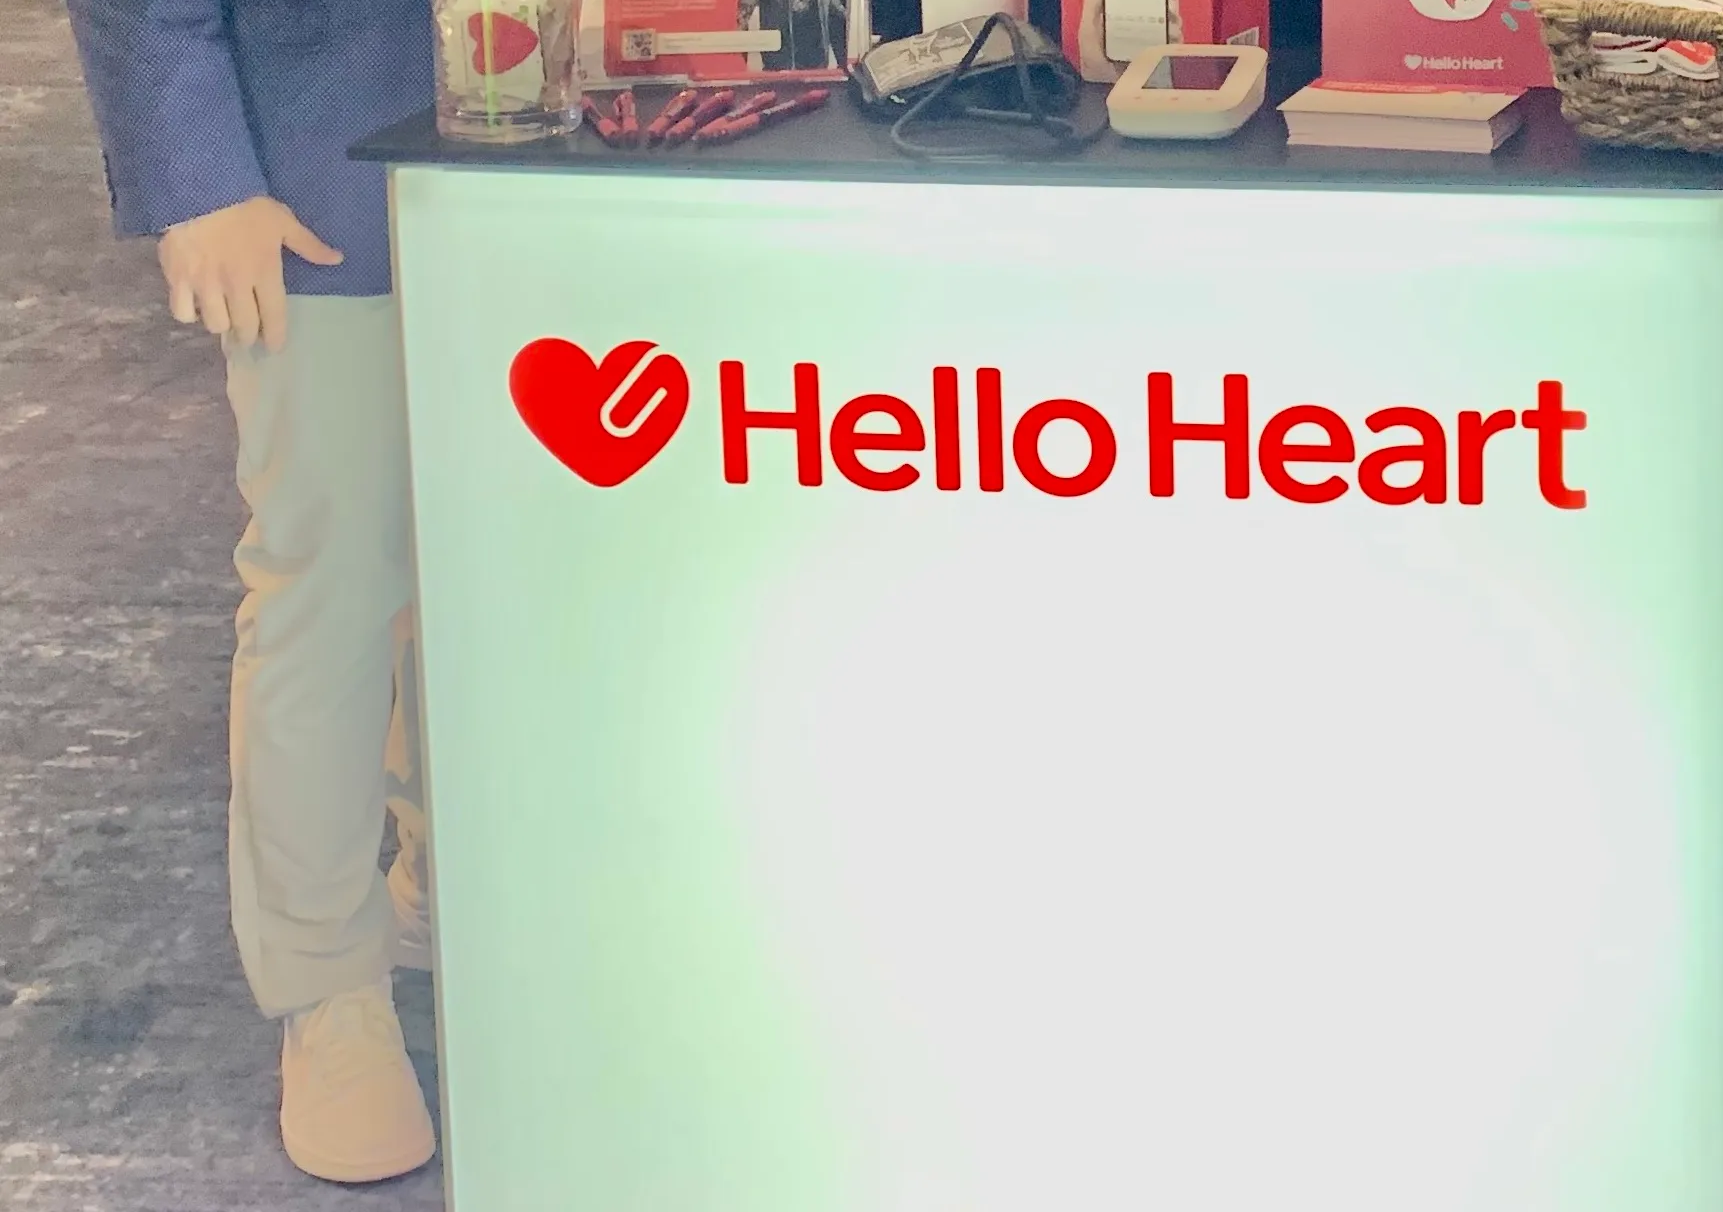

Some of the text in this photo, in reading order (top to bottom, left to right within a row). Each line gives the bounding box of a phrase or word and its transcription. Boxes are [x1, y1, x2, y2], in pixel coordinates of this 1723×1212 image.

[1423, 56, 1504, 71] Hello Heart
[717, 359, 1589, 510] Hello Heart
